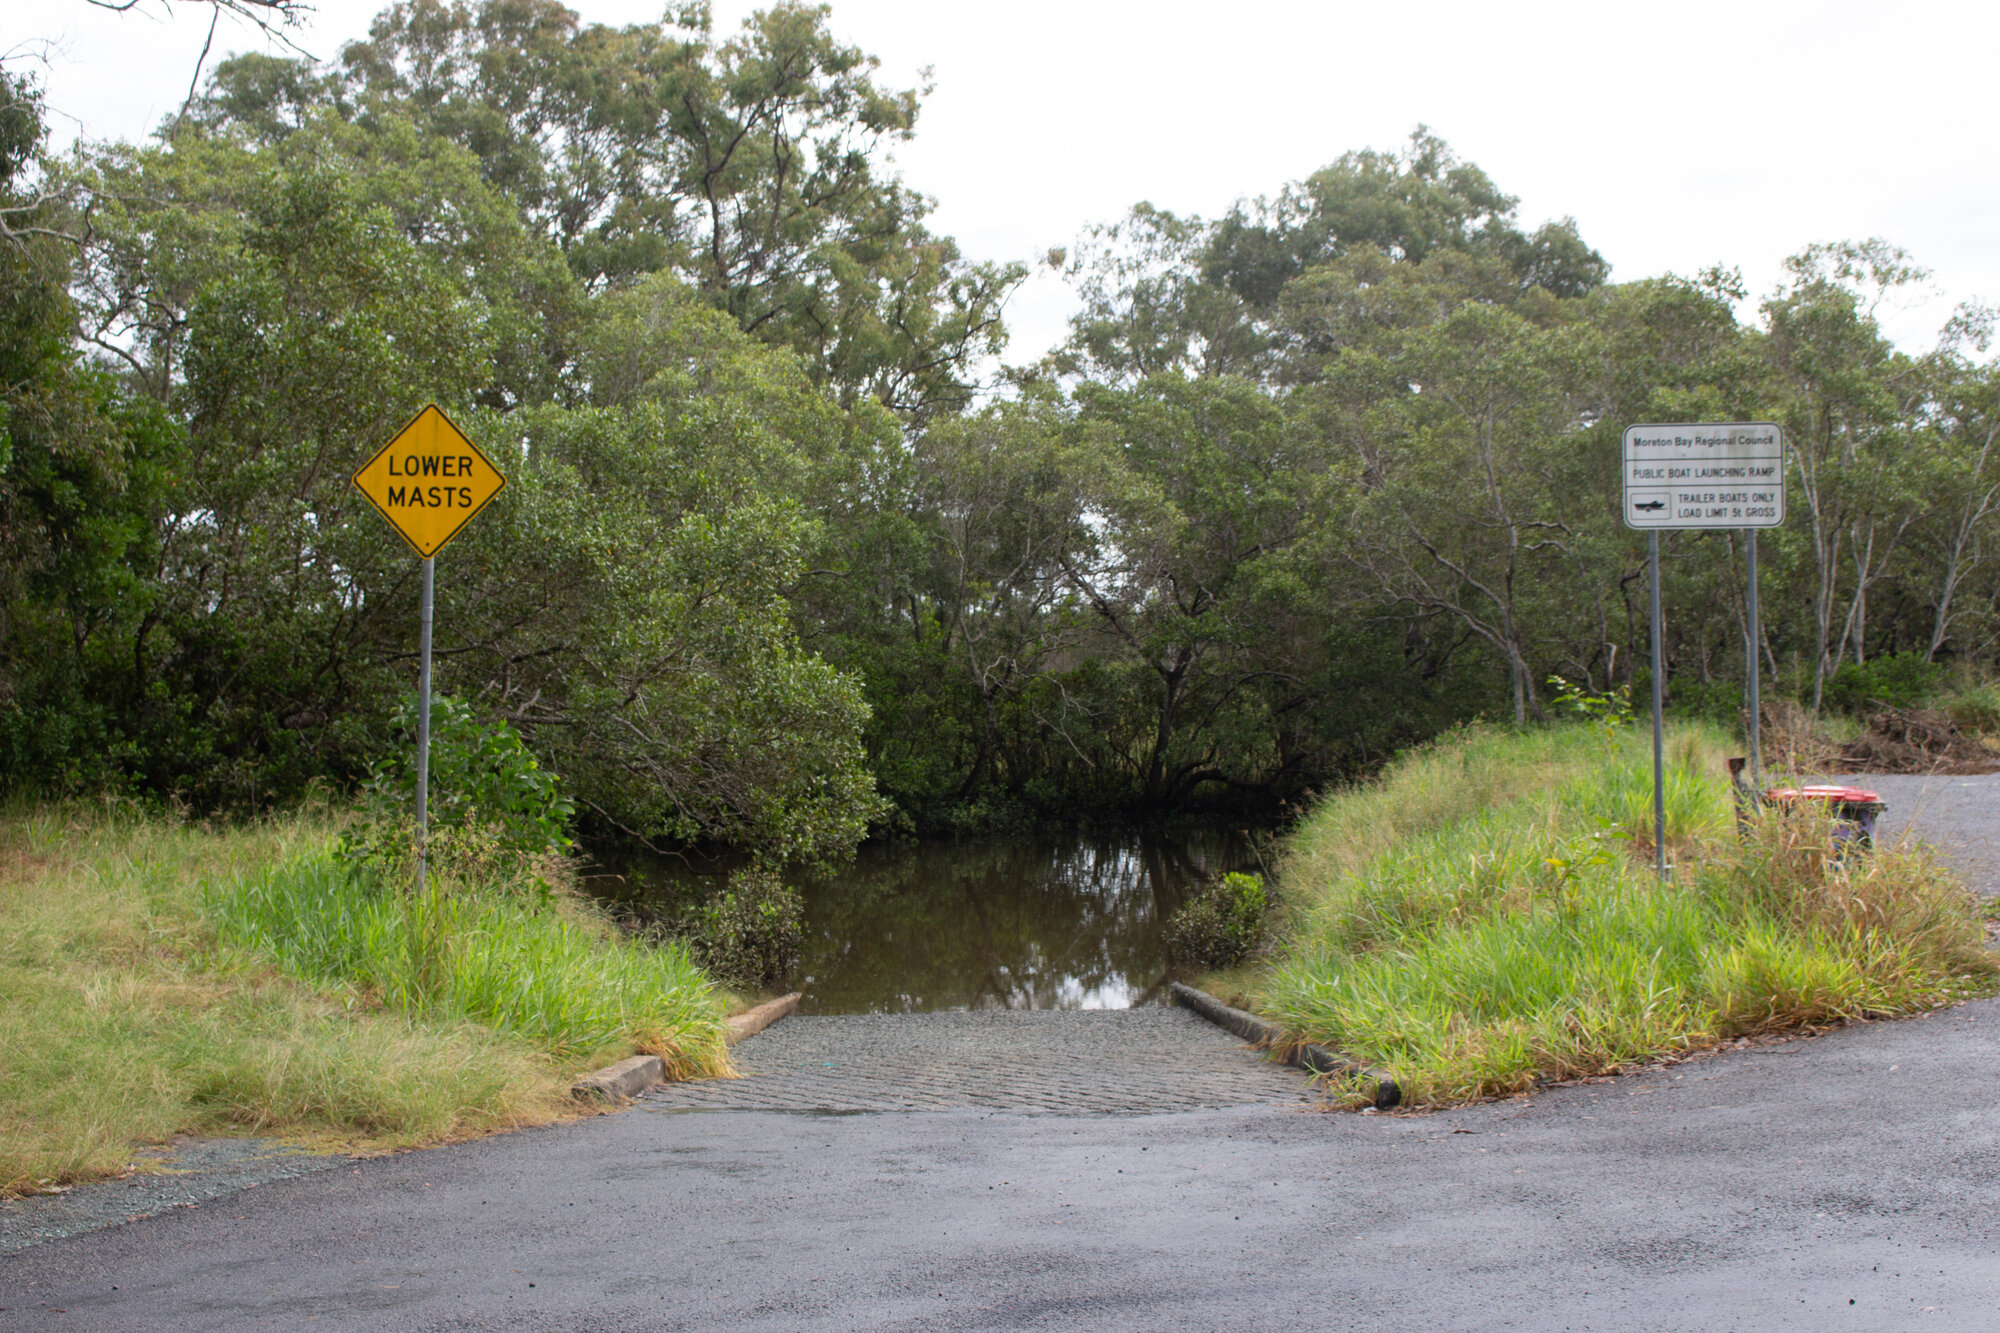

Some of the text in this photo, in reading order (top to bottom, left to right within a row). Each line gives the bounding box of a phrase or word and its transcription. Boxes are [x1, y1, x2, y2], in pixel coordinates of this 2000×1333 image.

[1633, 435, 1774, 448] Moreton Bay Regional Council
[389, 455, 473, 476] LOWER
[1633, 467, 1774, 478] PUBLIC BOAT LAUNCHING RAMP
[388, 486, 472, 508] MASTS
[1678, 493, 1775, 504] TRAILER BOATS ONLY
[1678, 507, 1775, 518] LOAD LIMIT 5t GROSS
